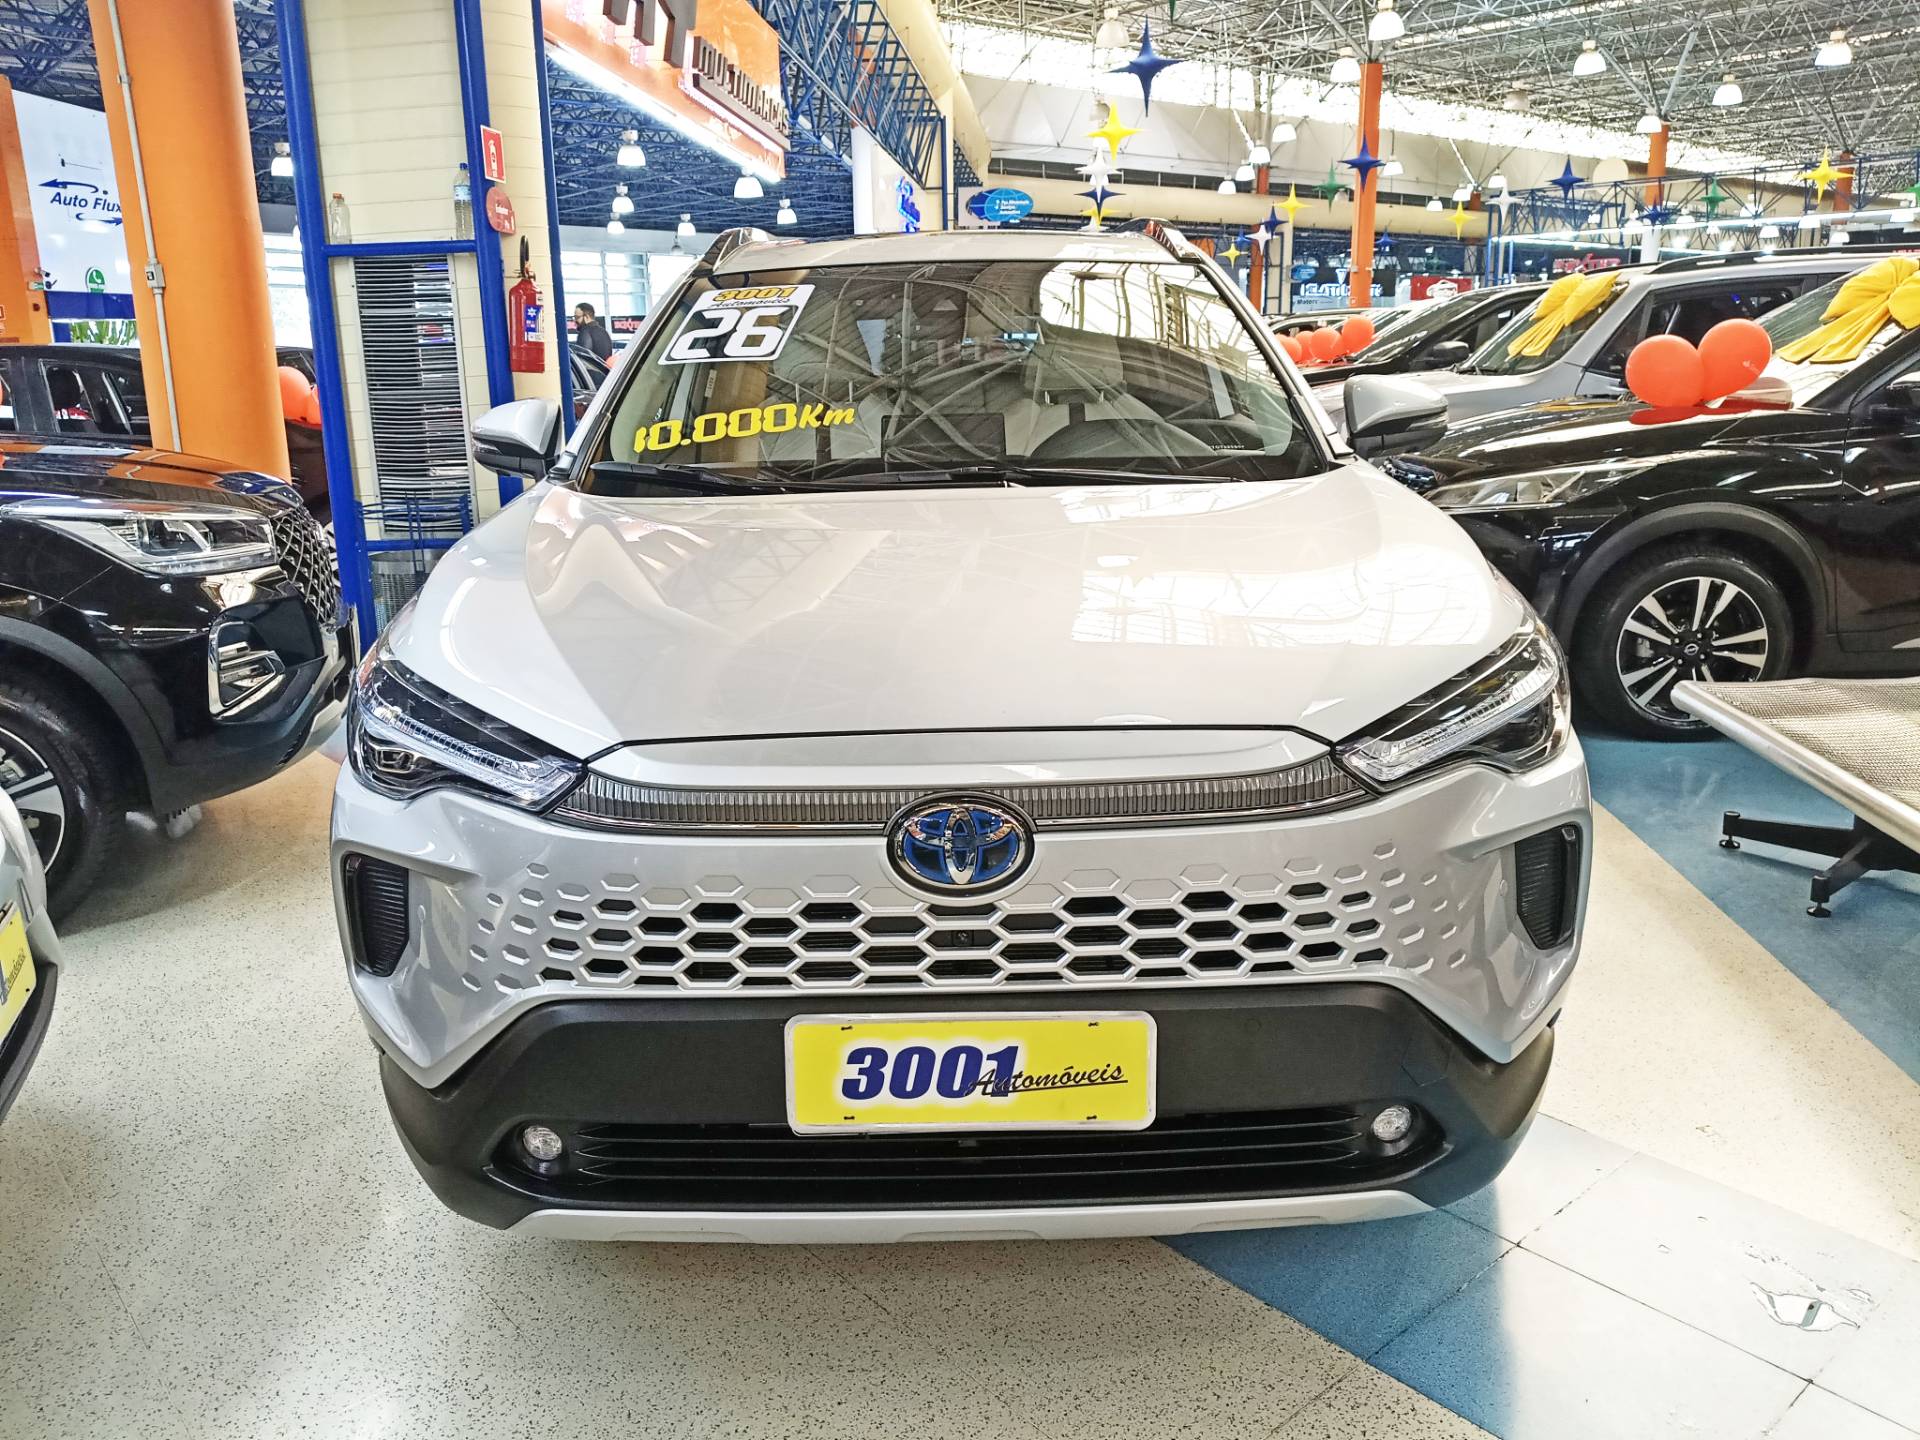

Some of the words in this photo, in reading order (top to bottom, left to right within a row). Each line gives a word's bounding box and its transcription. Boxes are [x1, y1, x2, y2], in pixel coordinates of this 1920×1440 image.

[50, 191, 88, 208] Auto
[92, 197, 122, 213] Flux
[712, 286, 799, 302] 3001
[669, 306, 791, 360] 26
[841, 1045, 1019, 1100] 3001
[965, 1063, 1128, 1097] Automóveis
